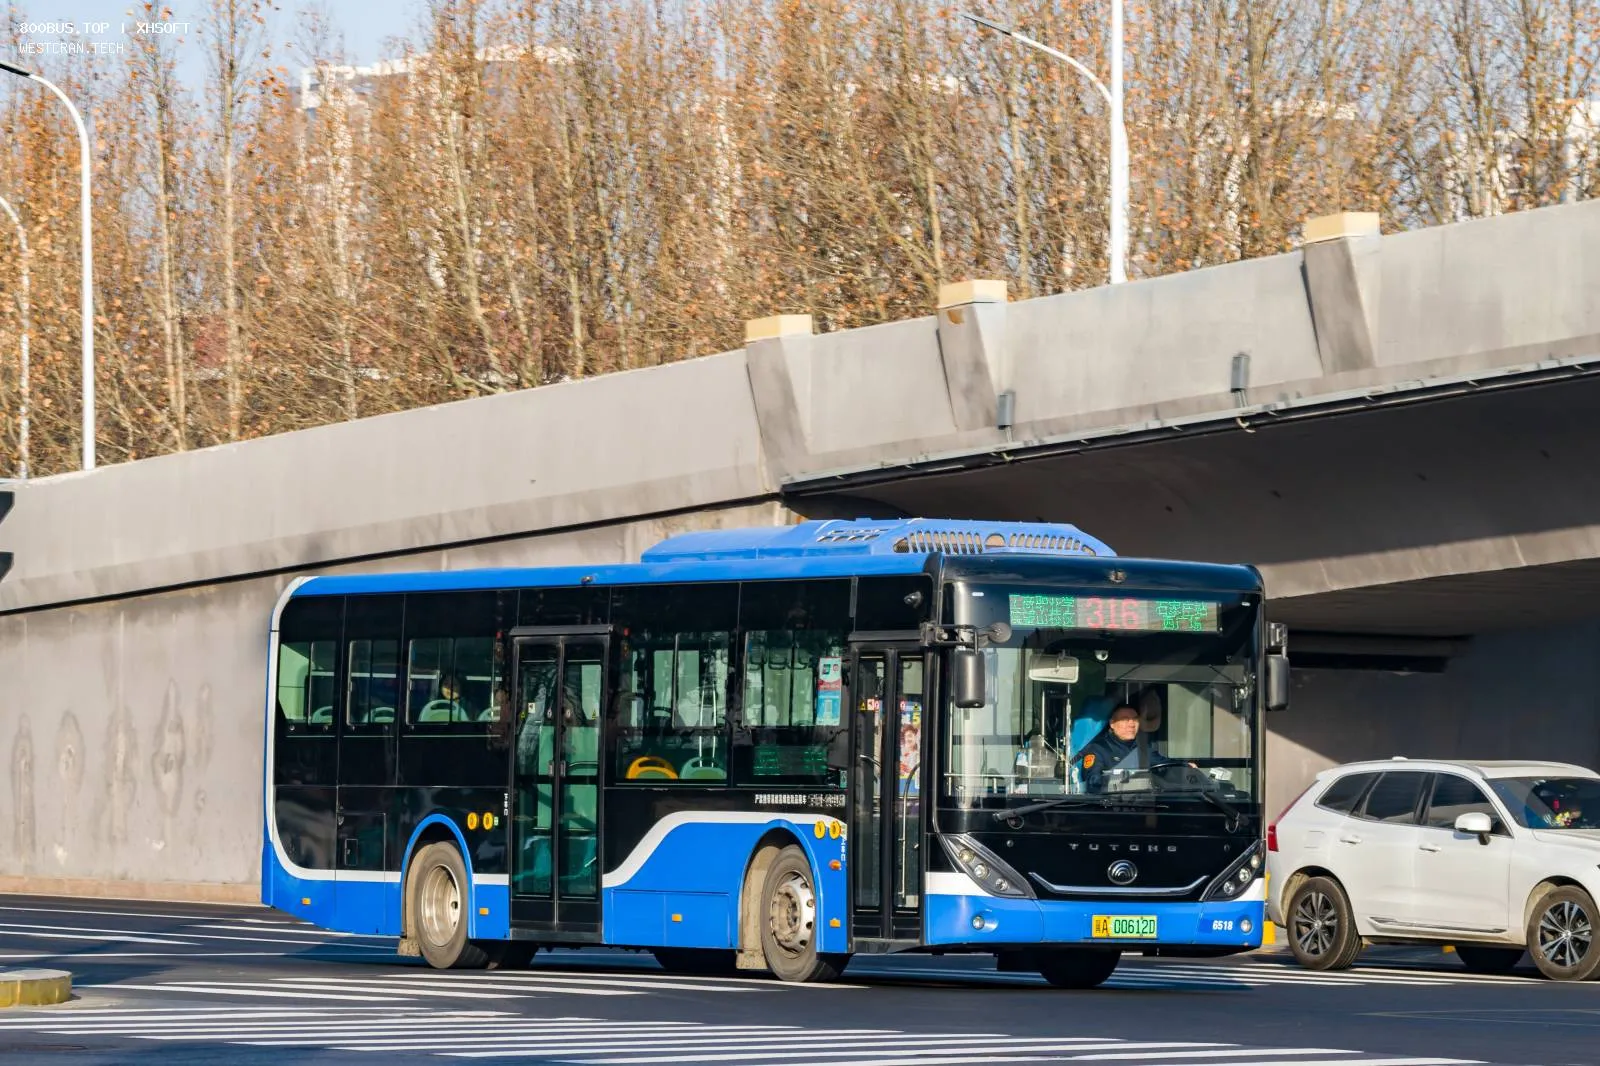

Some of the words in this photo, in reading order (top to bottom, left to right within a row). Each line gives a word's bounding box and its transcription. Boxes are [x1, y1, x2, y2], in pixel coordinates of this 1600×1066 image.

[1086, 596, 1139, 629] 316
[1114, 919, 1156, 934] 00612D
[1212, 920, 1233, 931] 6518
